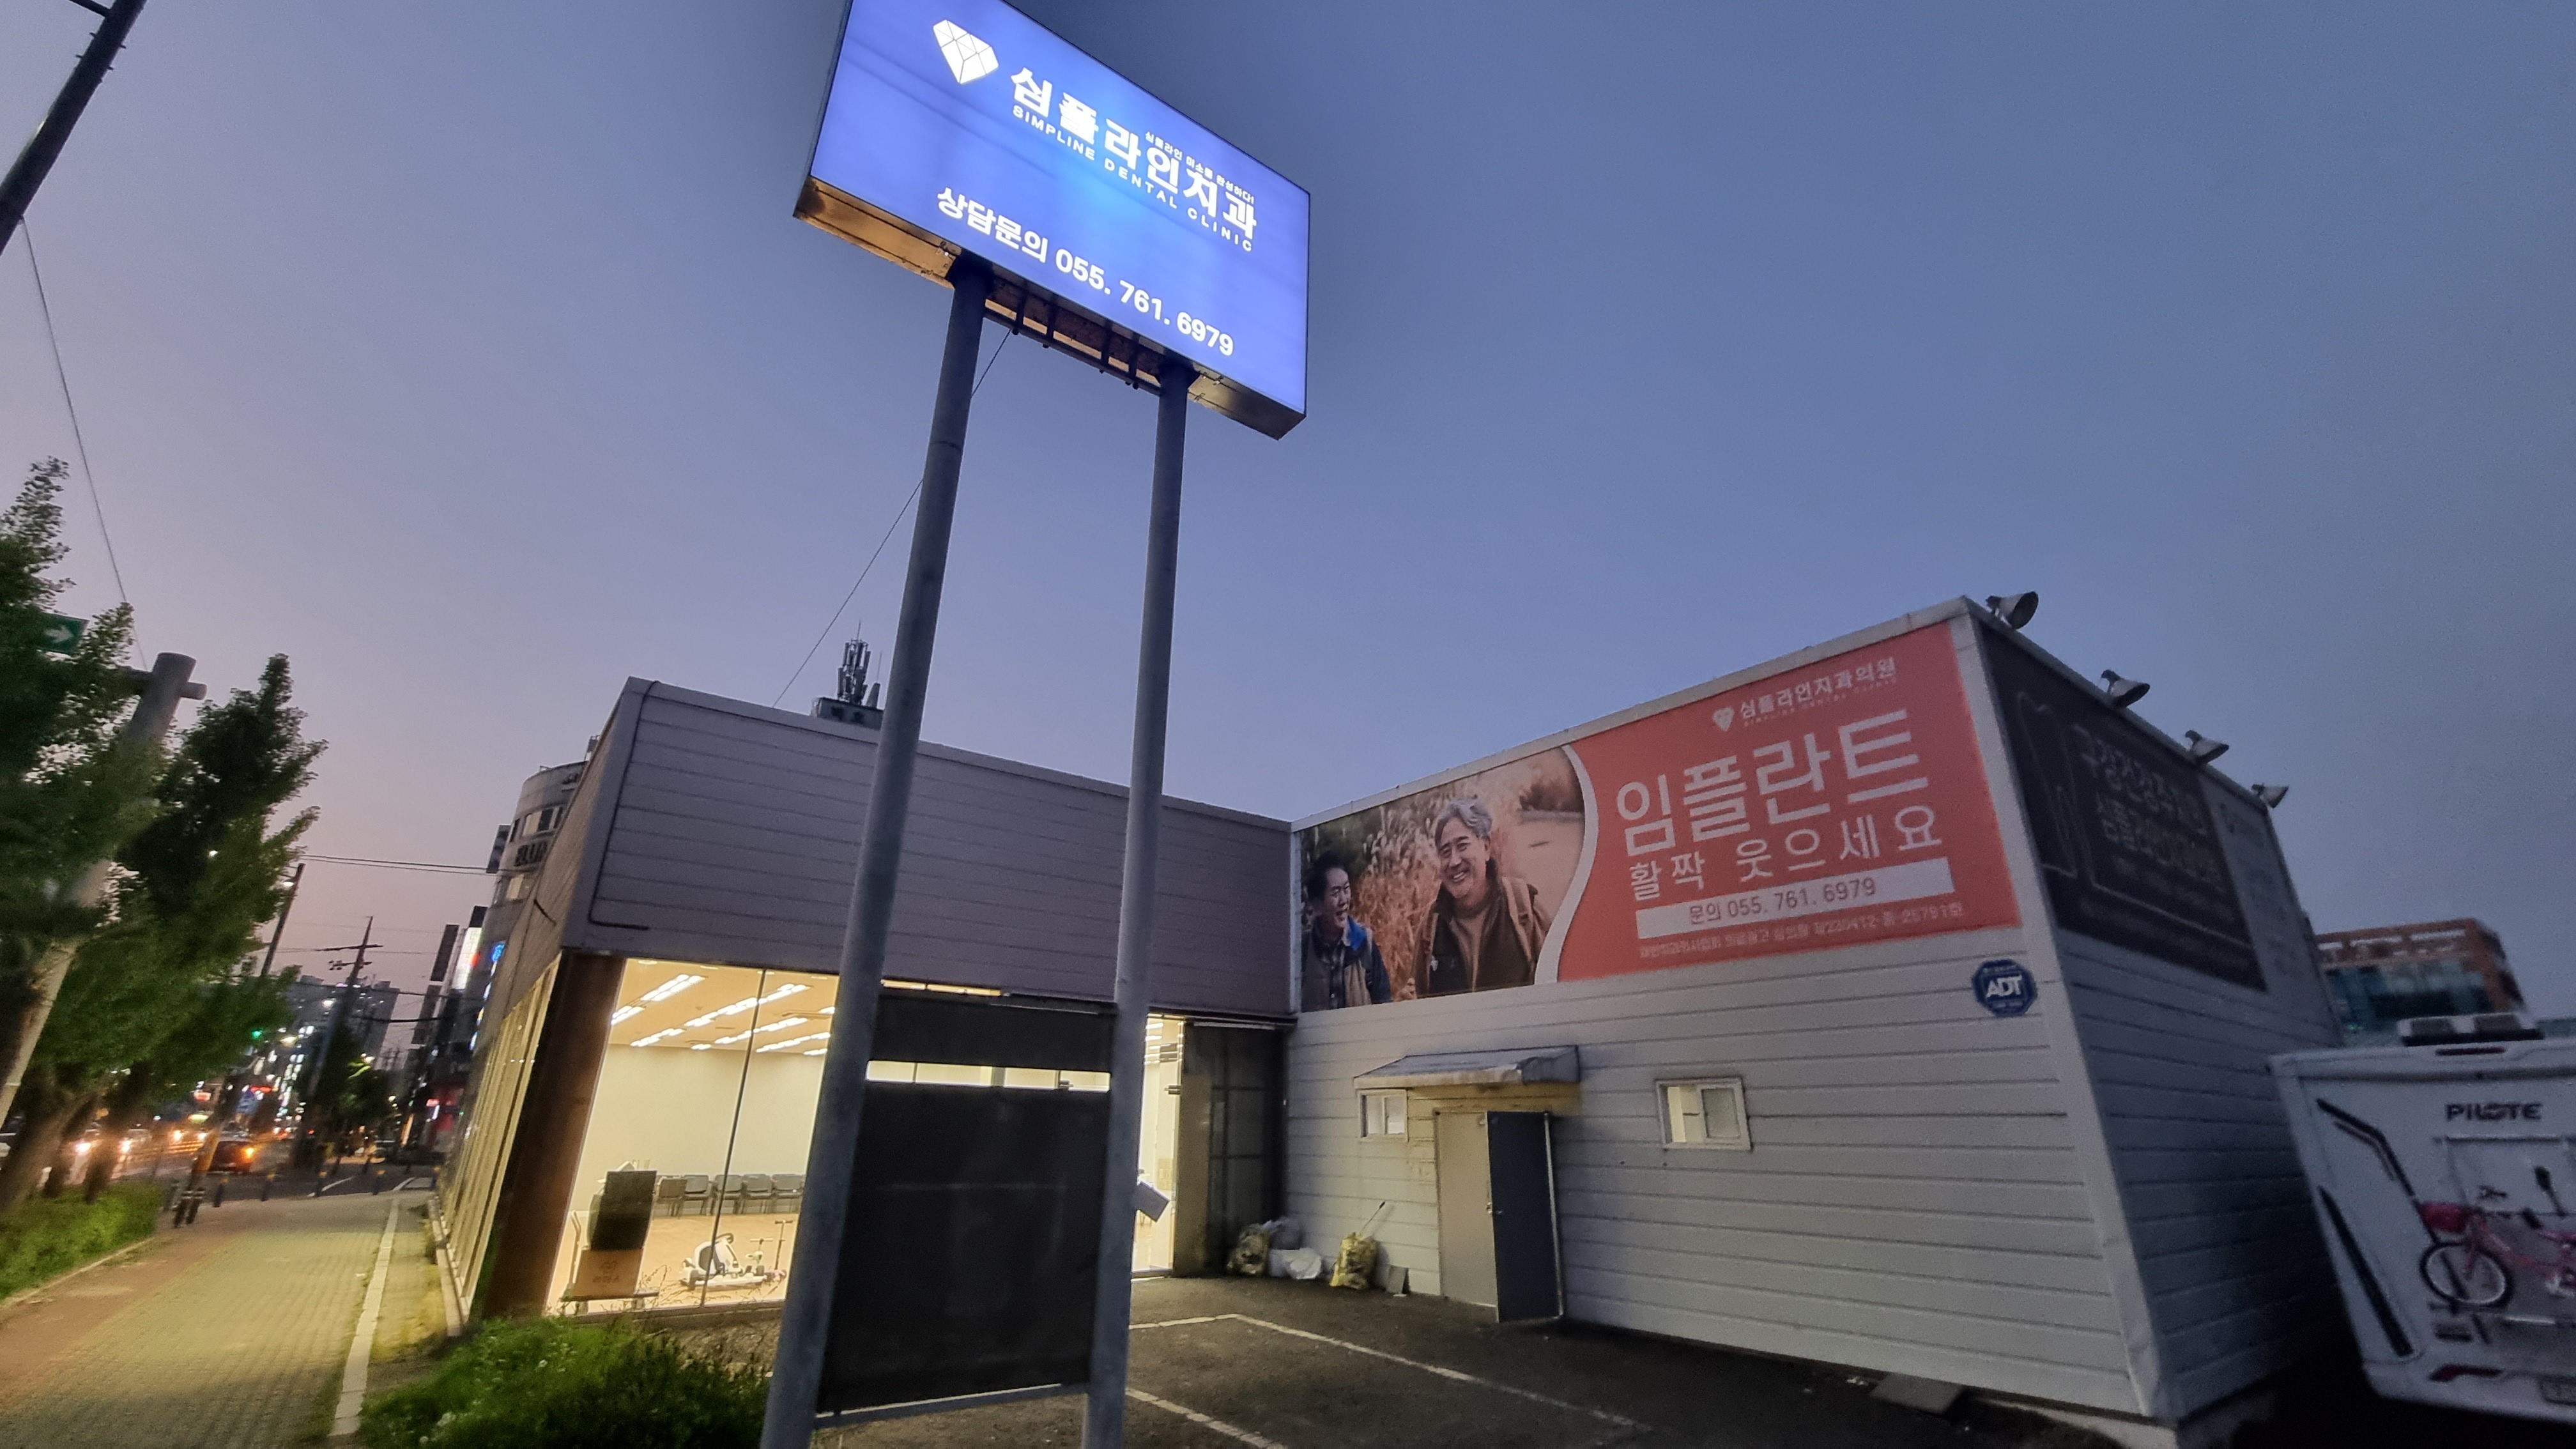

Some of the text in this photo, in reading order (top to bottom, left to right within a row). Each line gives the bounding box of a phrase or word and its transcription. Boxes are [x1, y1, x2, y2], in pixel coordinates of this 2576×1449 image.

[1011, 67, 1257, 240] 심플라인치과
[1013, 104, 1252, 252] SIMPLINE DENTAL CLINIC
[1145, 131, 1183, 161] 심플라인
[1186, 156, 1213, 180] 미소를
[937, 186, 1234, 357] 상담문의 055. 761. 6979
[1740, 657, 1897, 719] 심플라인치과의원
[1616, 709, 1929, 857] 임플란트
[1630, 804, 1942, 902] 활짝 웃으세요
[1690, 877, 1876, 924] 문의 055. 761. 6979
[1986, 975, 2022, 998] ADT
[2446, 1103, 2545, 1121] PILOTE
